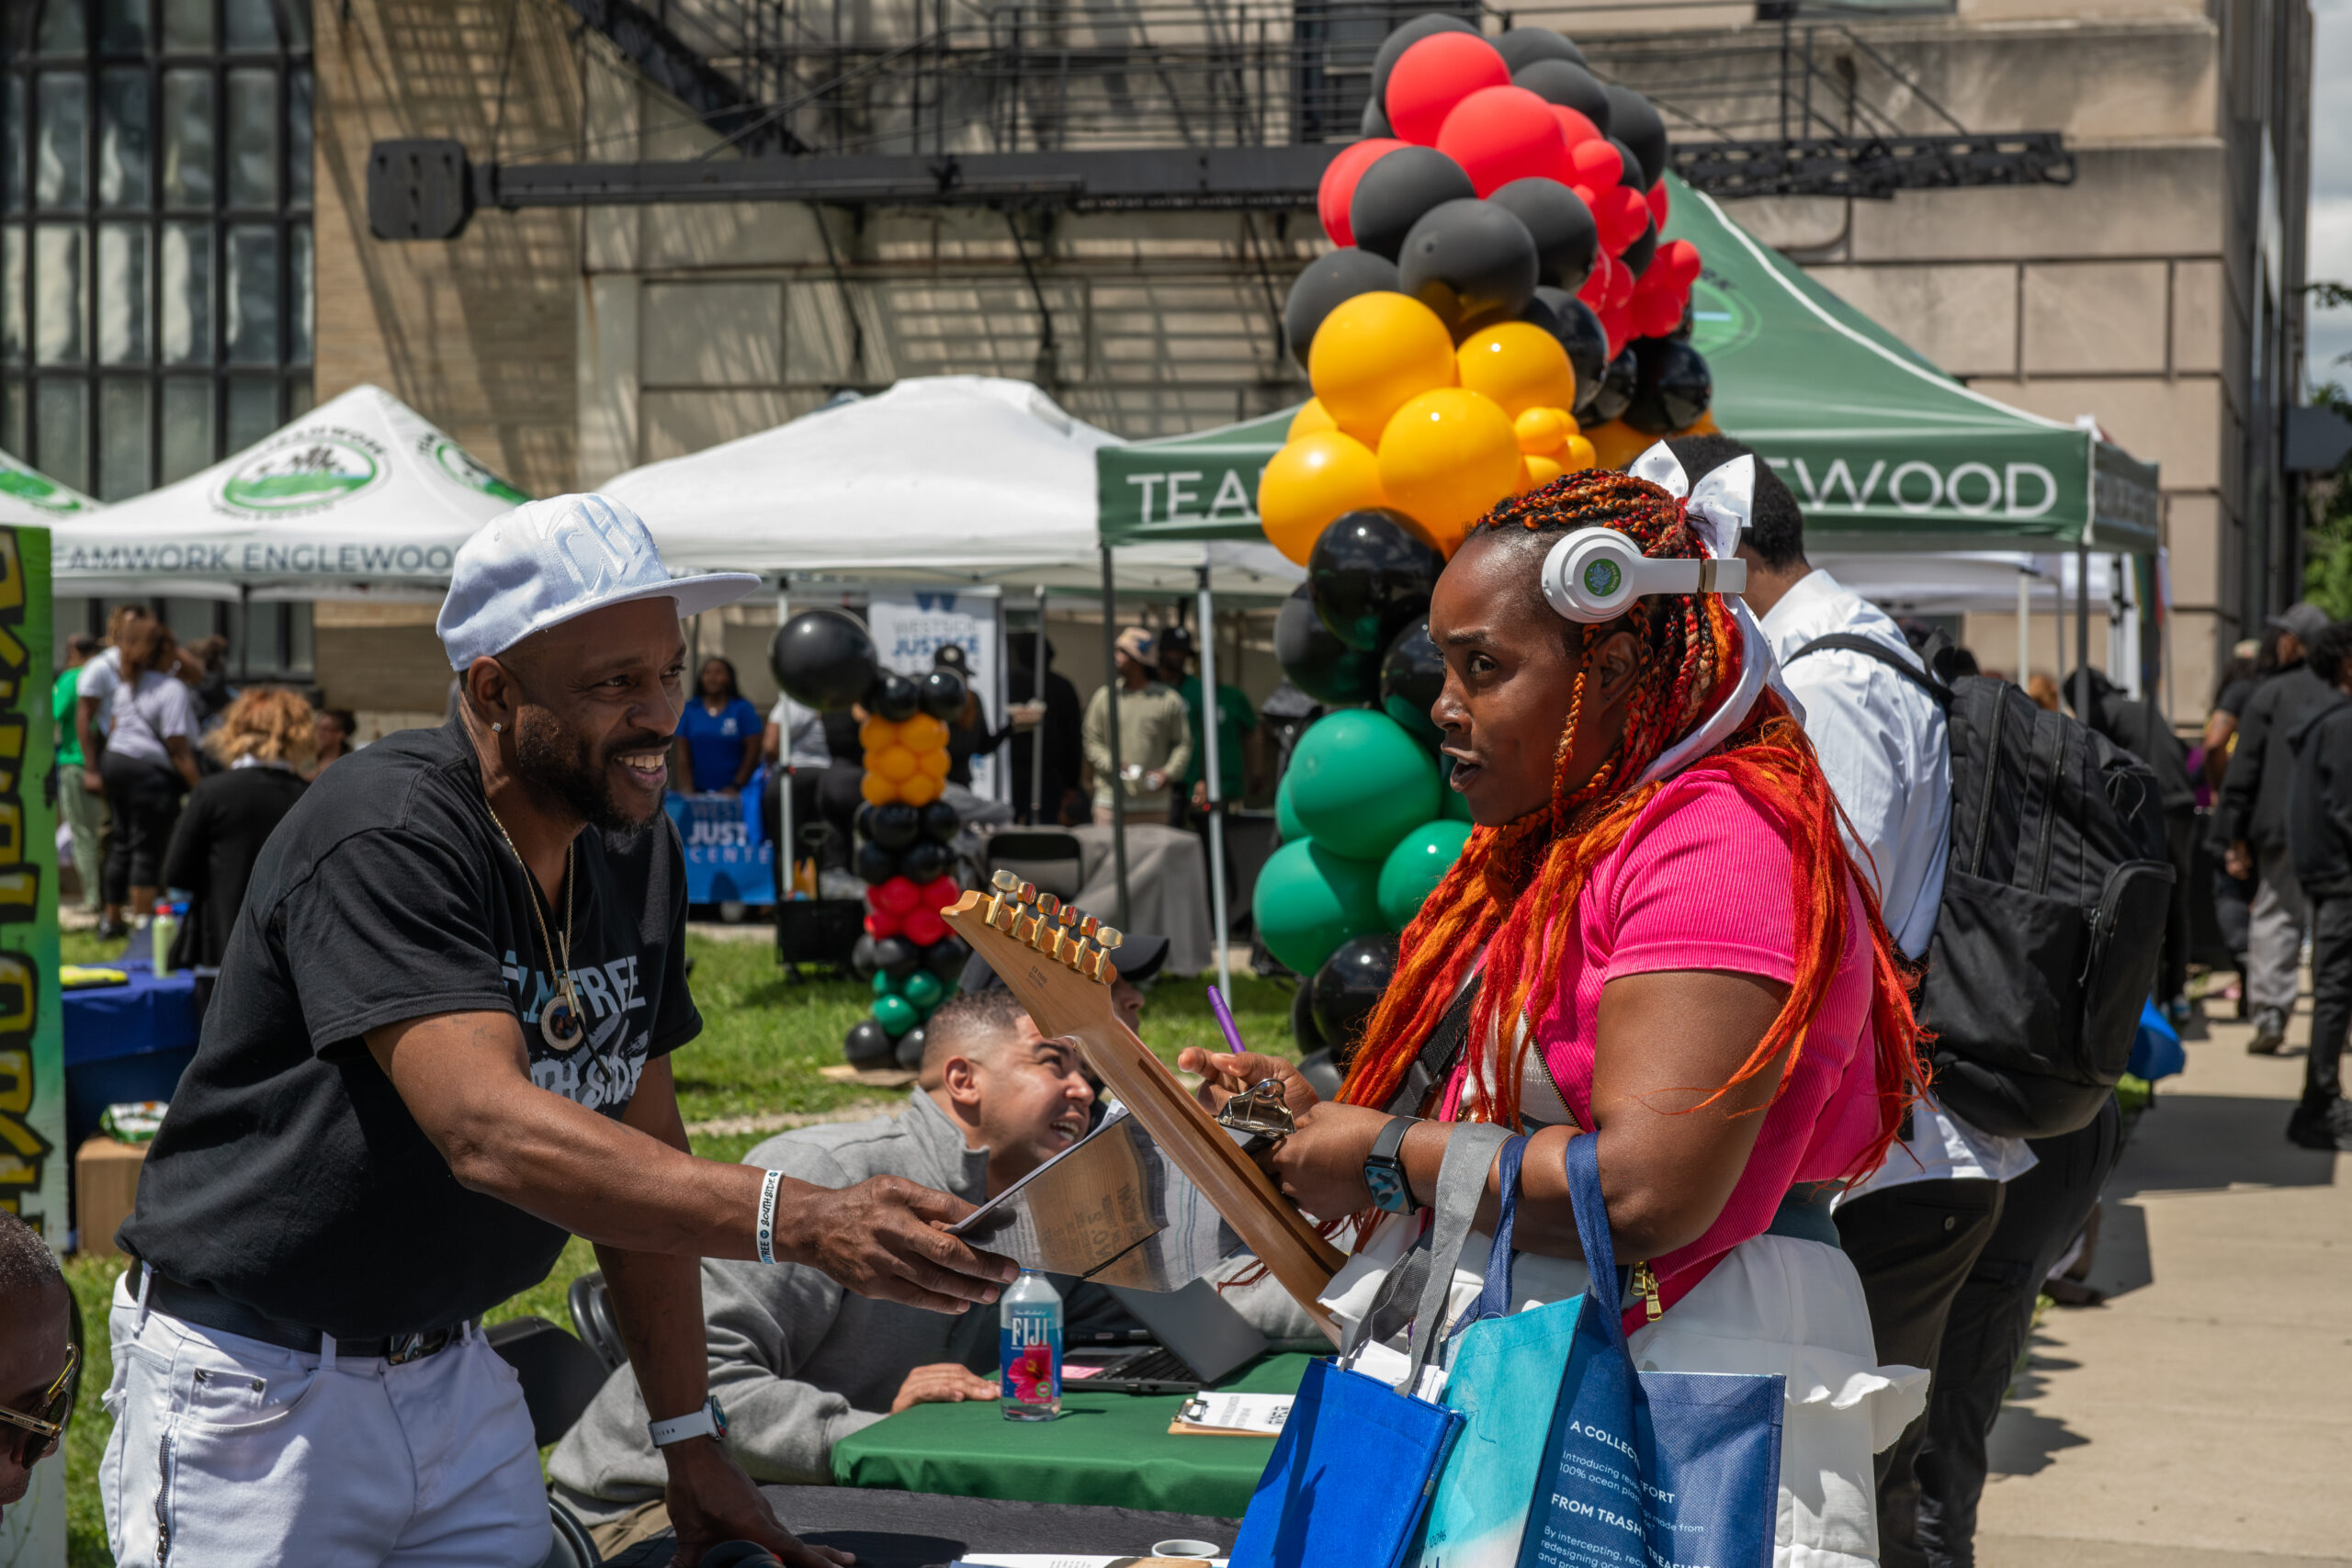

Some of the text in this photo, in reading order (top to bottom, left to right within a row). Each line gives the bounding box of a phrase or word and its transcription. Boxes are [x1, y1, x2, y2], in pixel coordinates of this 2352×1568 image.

[1125, 468, 1264, 525] TEA
[1766, 457, 2058, 517] WOOD
[51, 542, 460, 573] EAMWORK ENGLEWOO
[687, 820, 749, 847] JUST
[689, 845, 772, 865] CENTE
[1012, 1317, 1048, 1347] FIJI
[1560, 1462, 1587, 1479] 100%
[1589, 1473, 1620, 1492] ocean
[1570, 1420, 1676, 1505] A COLLECT FORT
[1563, 1450, 1620, 1479] Introducing
[1679, 1523, 1704, 1533] from
[1551, 1494, 1594, 1517] FROM
[1598, 1507, 1643, 1538] TRASH
[1538, 1551, 1556, 1566] and
[1541, 1540, 1600, 1568] redesigning
[1544, 1525, 1647, 1568] By intercepting, recy
